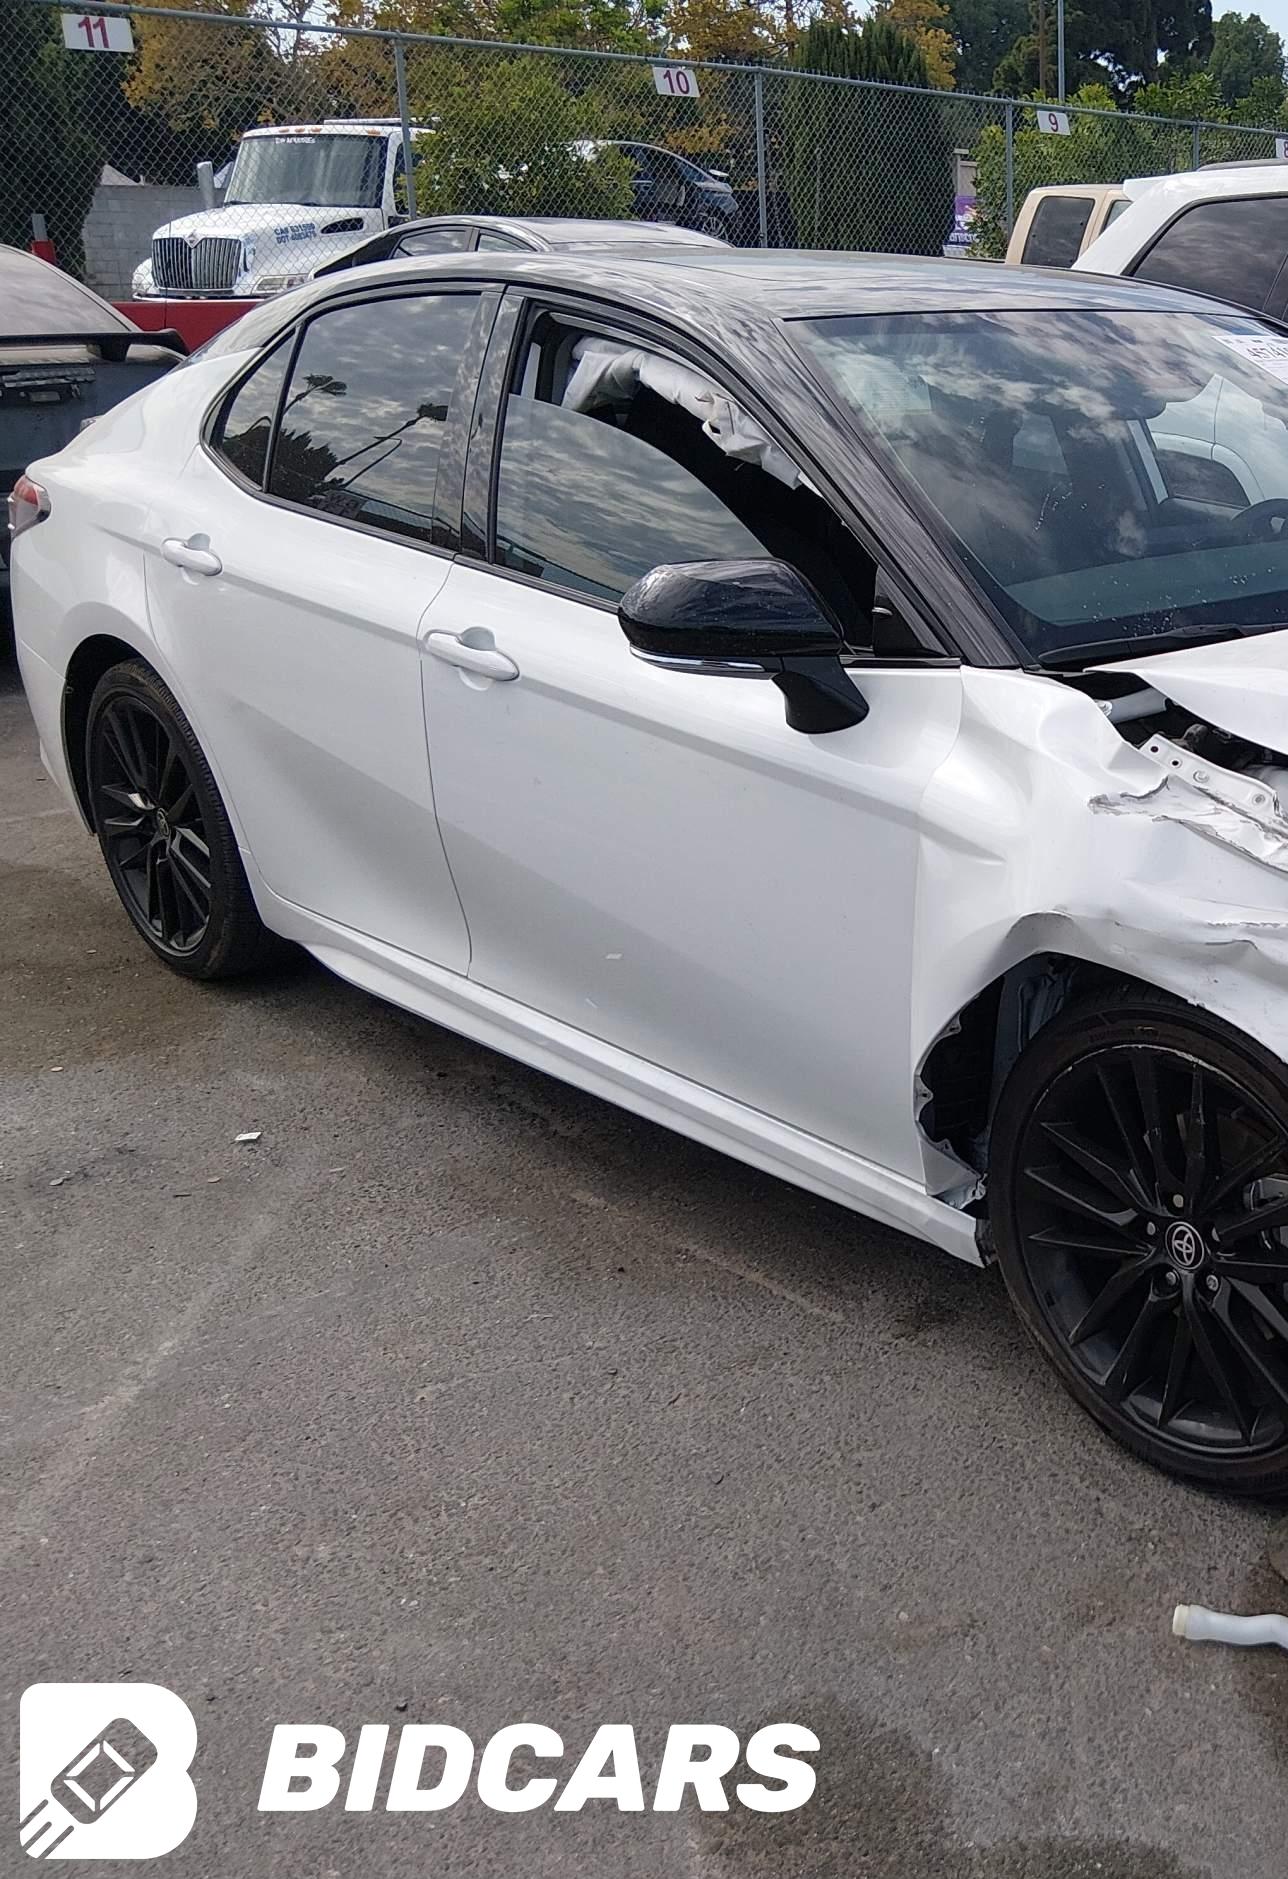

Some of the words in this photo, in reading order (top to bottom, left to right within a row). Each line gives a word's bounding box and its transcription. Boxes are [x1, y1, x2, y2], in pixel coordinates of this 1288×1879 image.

[78, 16, 110, 49] 11
[663, 70, 690, 94] 10
[1048, 113, 1059, 132] 9
